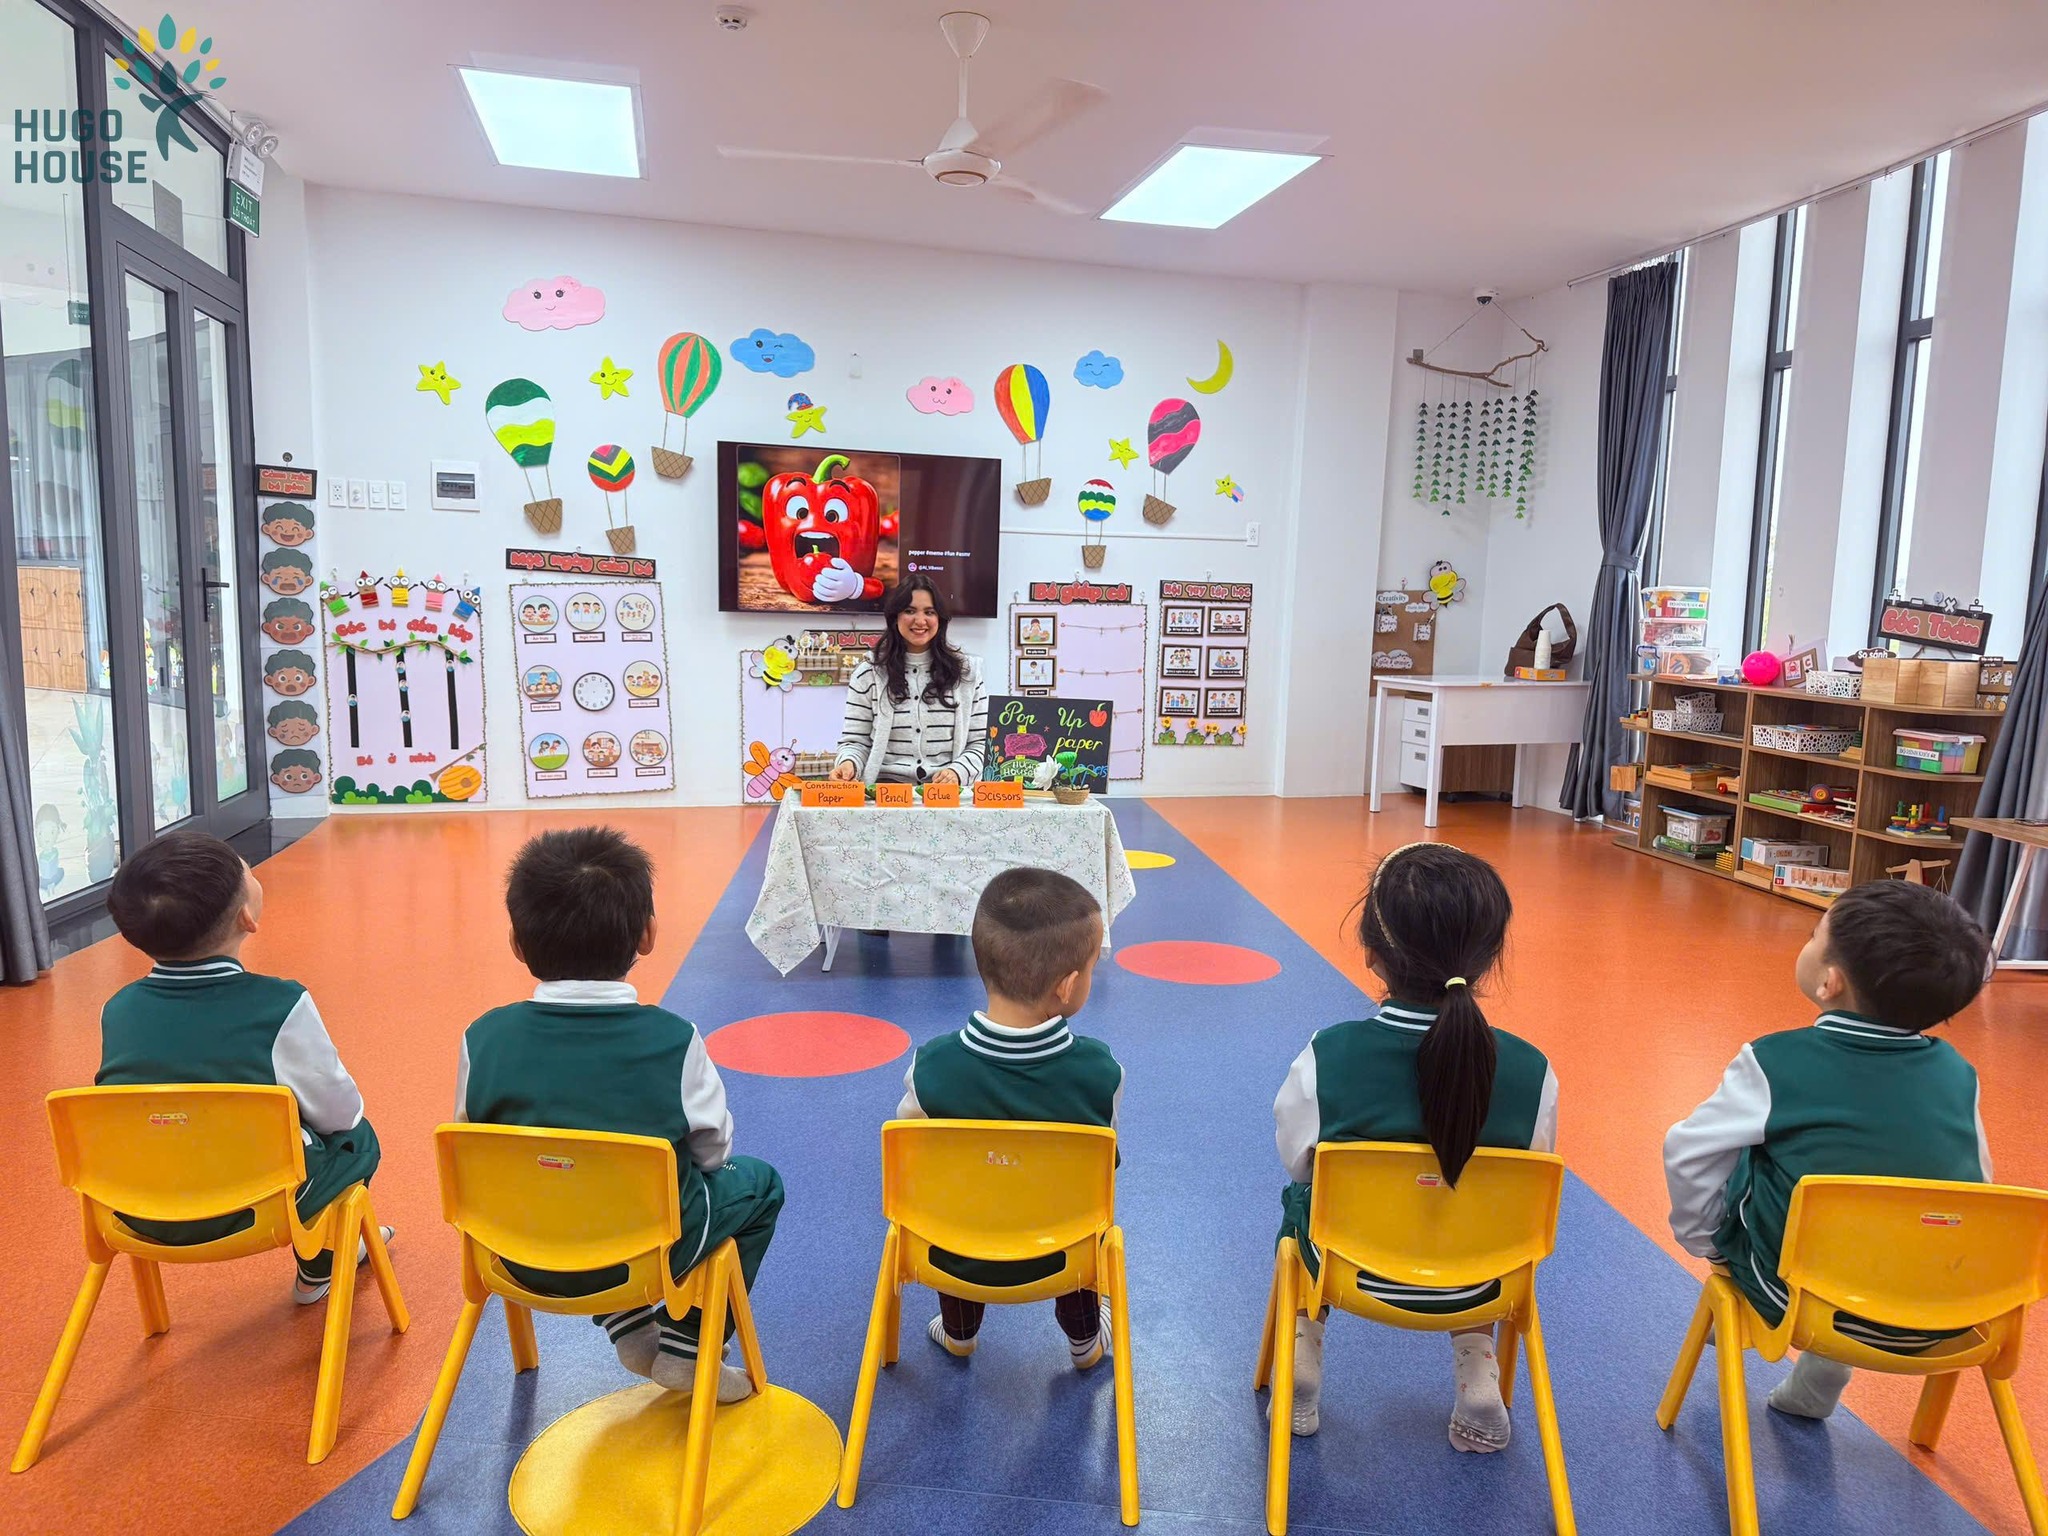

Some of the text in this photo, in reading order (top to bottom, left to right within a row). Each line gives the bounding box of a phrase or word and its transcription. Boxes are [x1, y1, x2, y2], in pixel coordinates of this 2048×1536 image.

[236, 191, 253, 213] EXIT
[1034, 580, 1128, 604] Bé giúp cô
[1232, 585, 1251, 599] học
[1378, 594, 1406, 602] Creativity
[335, 621, 367, 636] Góc
[378, 619, 396, 631] bé
[1882, 608, 1981, 645] Góc Toán
[838, 631, 856, 646] bé
[1869, 650, 1888, 658] sánh
[1804, 659, 1811, 667] C
[999, 700, 1087, 736] Pop Up
[1052, 737, 1103, 757] paper
[805, 781, 858, 790] Construction
[926, 786, 951, 801] Glue
[976, 784, 1021, 801] Scissors
[818, 792, 844, 804] Paper
[879, 786, 909, 804] Pencil
